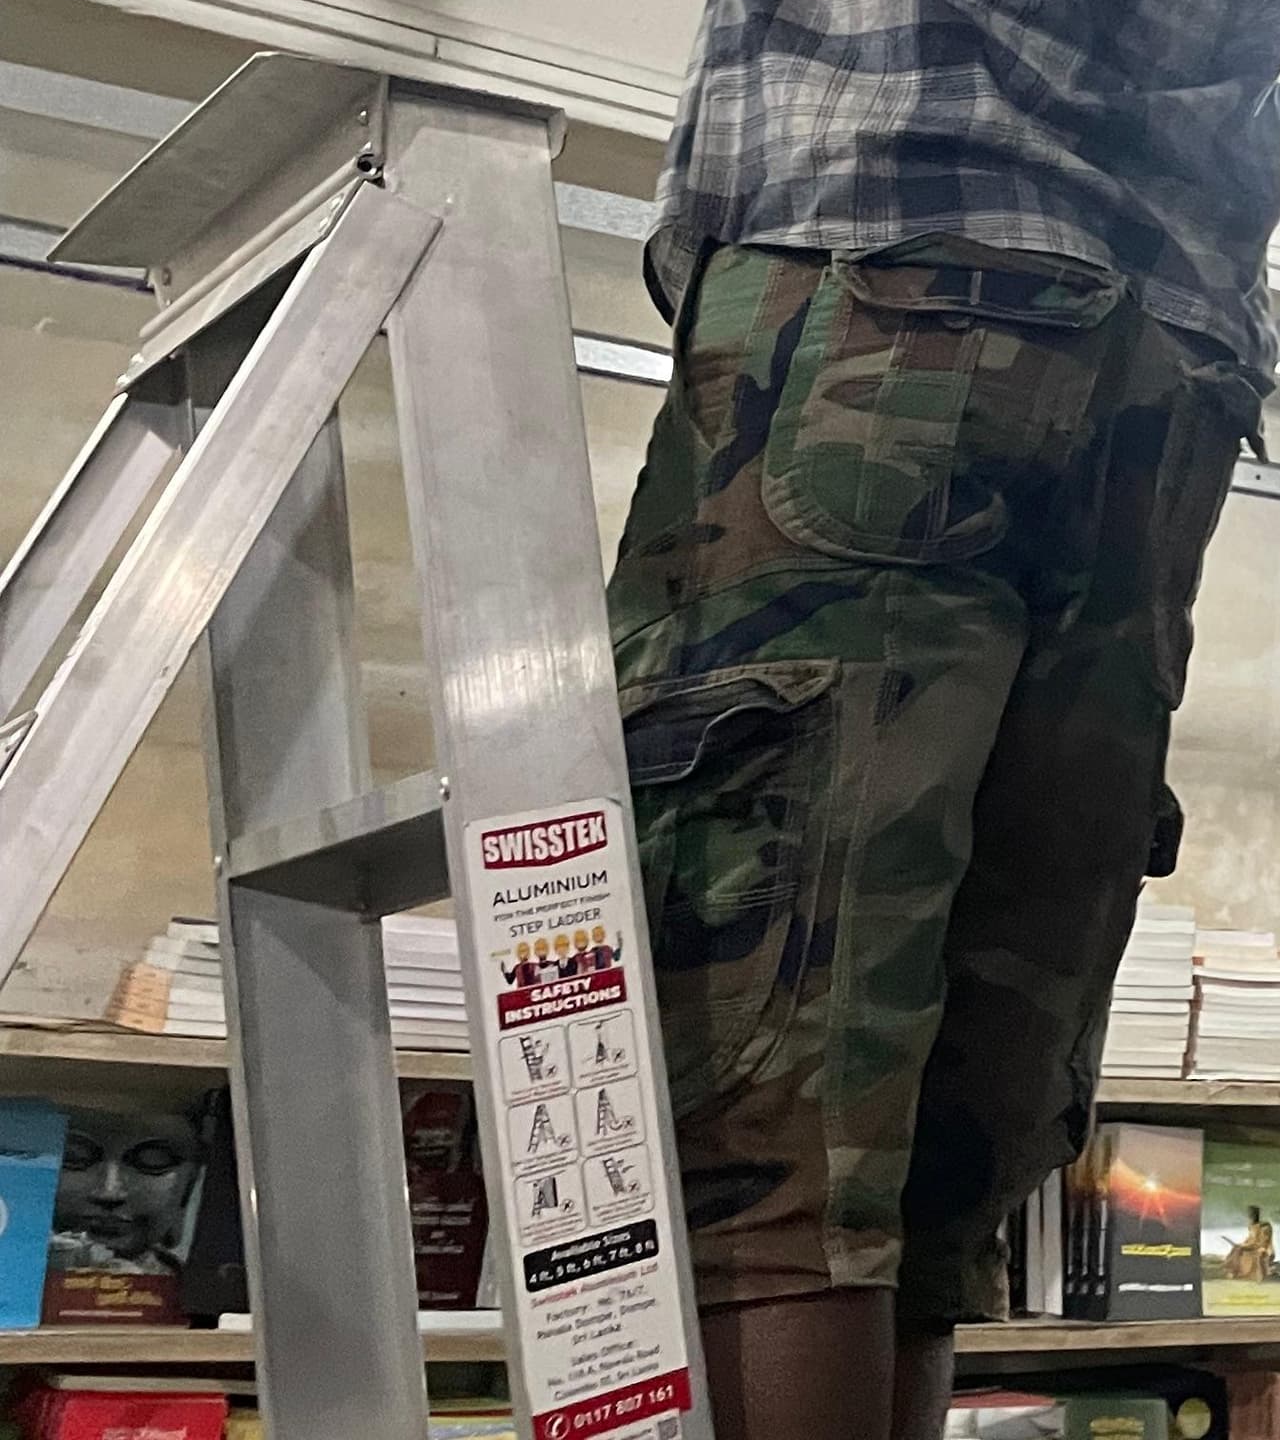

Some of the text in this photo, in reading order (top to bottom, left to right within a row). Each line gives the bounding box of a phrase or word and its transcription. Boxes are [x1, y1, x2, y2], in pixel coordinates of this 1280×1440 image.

[484, 815, 606, 862] SWISSTEK
[493, 870, 608, 907] ALUMINIUM
[510, 907, 601, 938] STEP LADDER
[504, 985, 621, 1025] INSTRUCTIONS
[531, 977, 591, 1003] SAFETY
